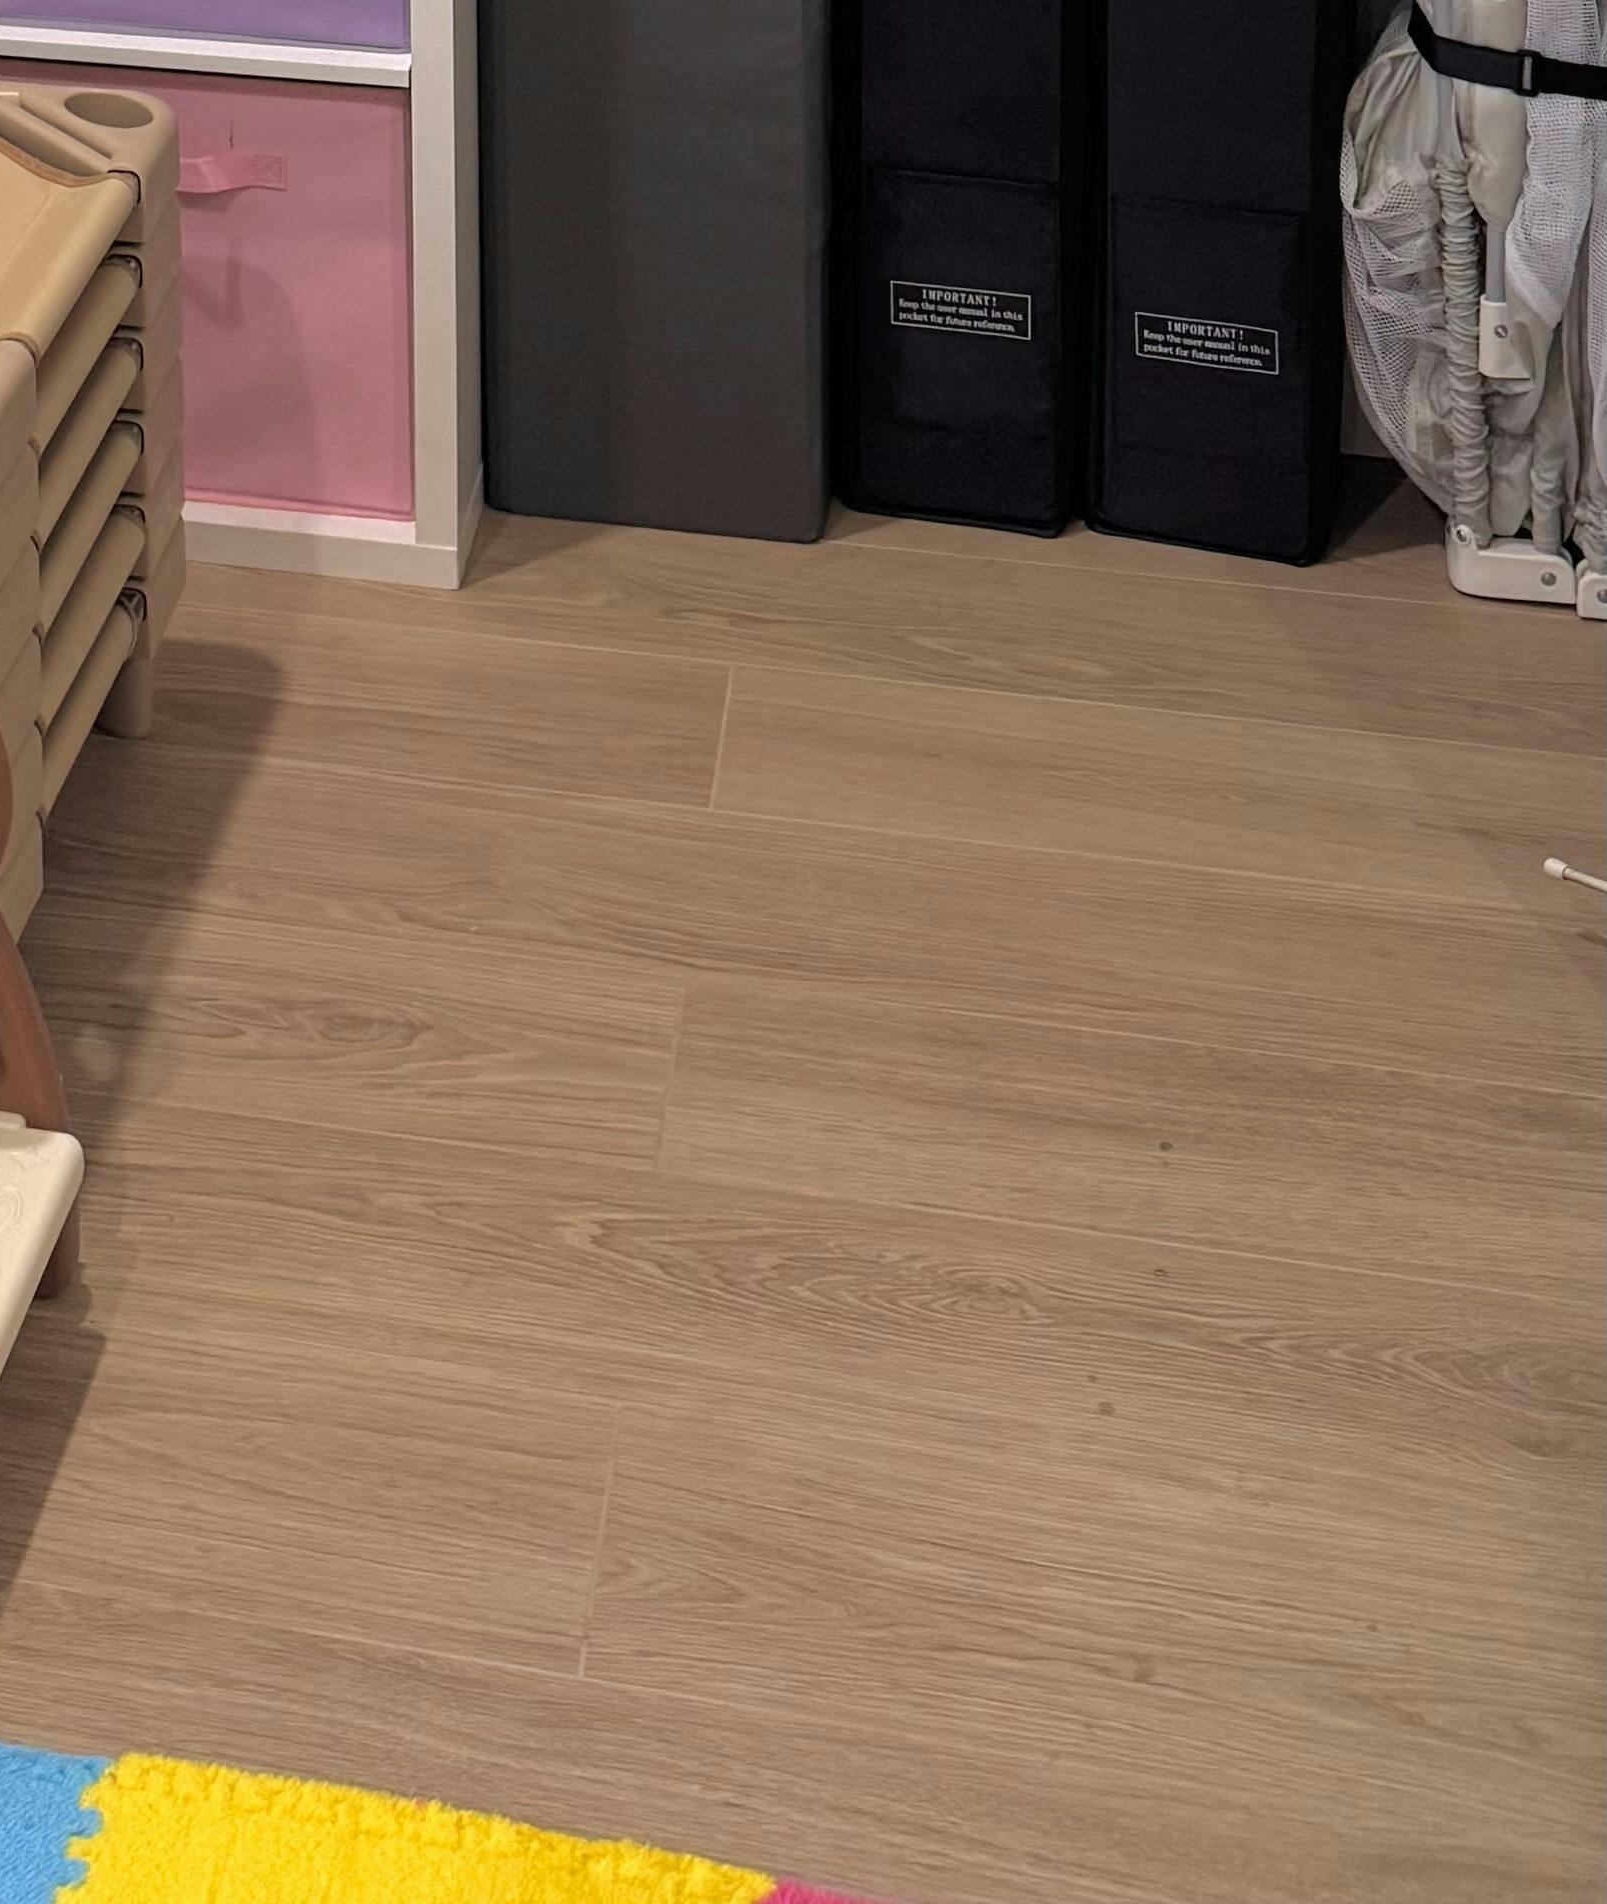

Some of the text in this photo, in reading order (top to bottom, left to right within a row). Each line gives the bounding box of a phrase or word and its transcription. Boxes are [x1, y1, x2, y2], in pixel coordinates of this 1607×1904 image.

[922, 289, 997, 307] IMPORTANT!
[898, 298, 920, 310] Keep
[921, 301, 936, 311] the
[991, 309, 1002, 319] in
[1003, 311, 1023, 321] this
[930, 313, 944, 324] for
[945, 316, 972, 328] future
[1167, 320, 1244, 340] IMPORTANT!
[1143, 329, 1165, 341] Keep
[1166, 333, 1181, 343] the
[1238, 342, 1249, 352] in
[1250, 344, 1271, 355] this
[1175, 346, 1189, 357] for
[1191, 349, 1218, 361] future
